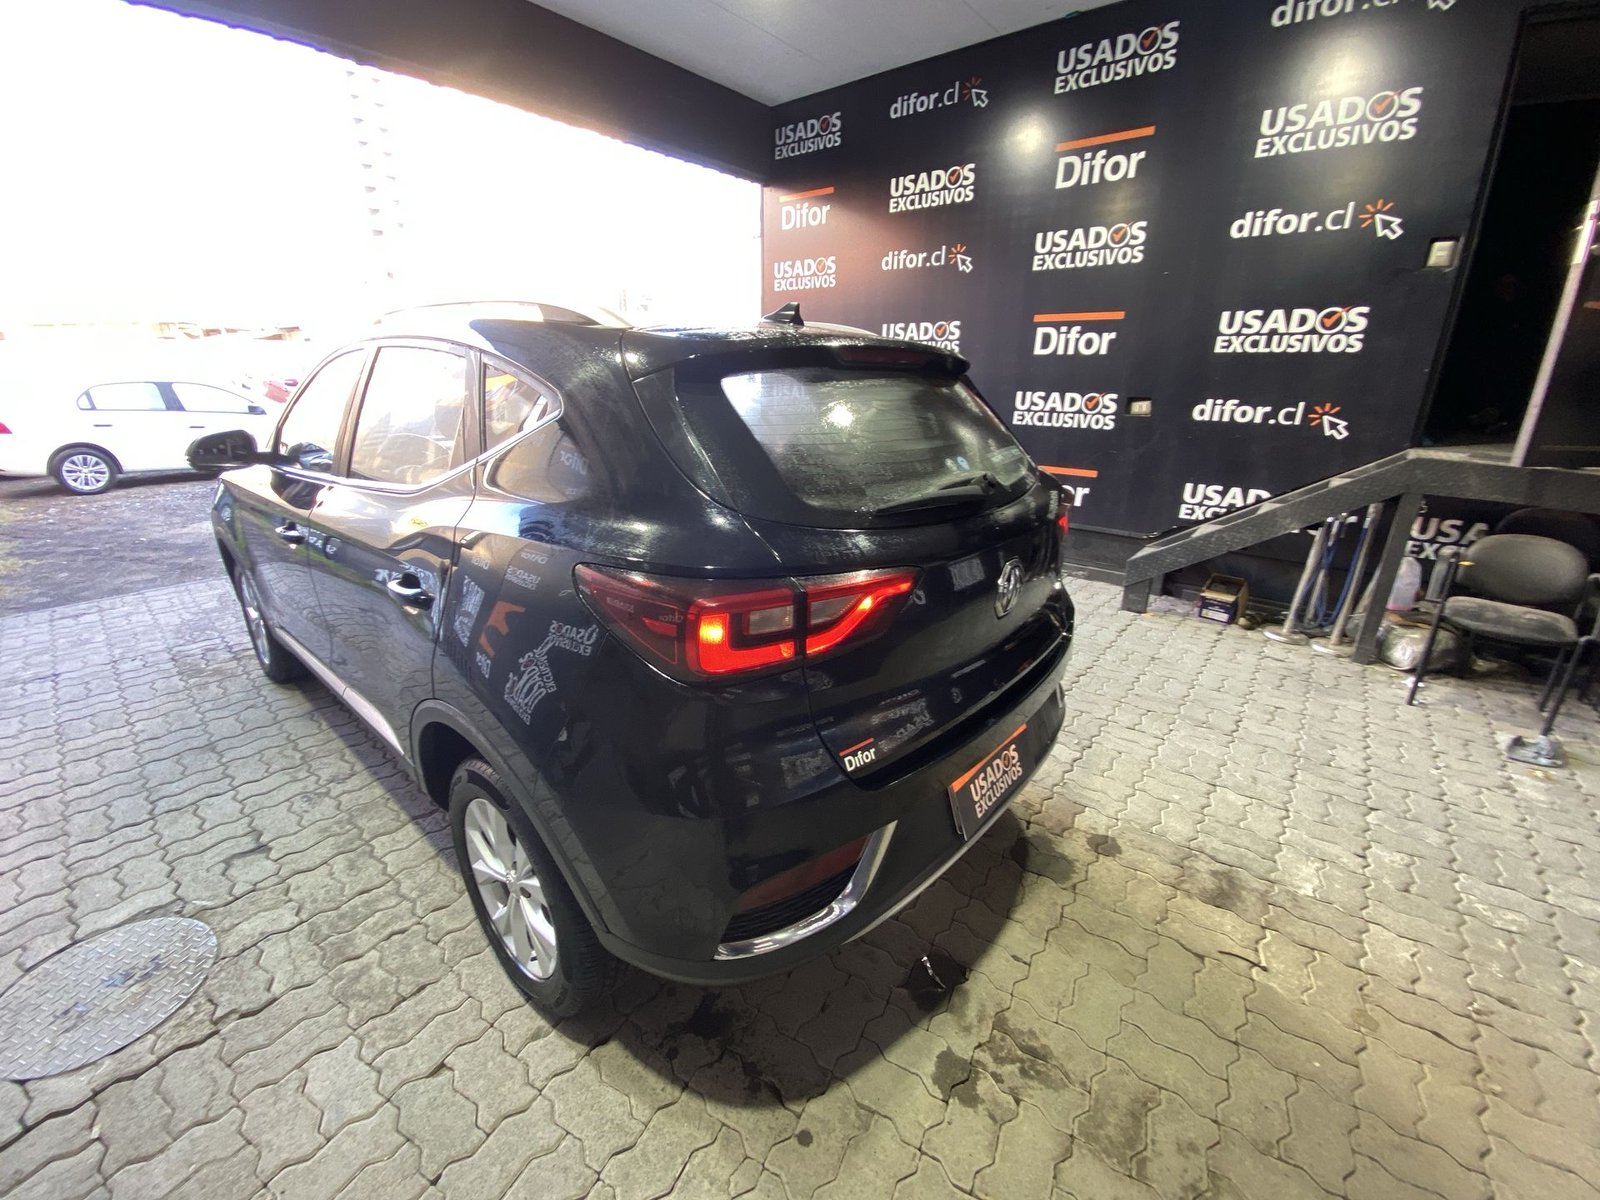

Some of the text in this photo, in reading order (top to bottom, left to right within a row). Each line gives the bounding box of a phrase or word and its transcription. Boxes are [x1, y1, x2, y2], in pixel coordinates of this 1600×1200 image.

[1270, 0, 1399, 27] difor.
[1057, 20, 1180, 74] USADOS
[1054, 48, 1177, 94] EXCLUSIVOS
[889, 81, 960, 119] difor.cl
[1260, 87, 1423, 136] USADOS
[775, 112, 842, 145] USADOS
[1254, 118, 1418, 158] EXCLUSIVOS
[774, 135, 842, 160] EXCLUSIVOS
[890, 163, 976, 197] USADOS
[1055, 150, 1146, 190] Difor
[889, 185, 974, 213] EXCLUSIVOS
[781, 202, 830, 231] Difor
[1230, 202, 1356, 239] difor.cl
[1035, 221, 1148, 254] USADOS
[774, 256, 836, 279] USADOS
[881, 245, 946, 272] difor.cl
[1032, 246, 1144, 271] EXCLUSIVOS
[774, 273, 836, 291] EXCLUSIVOS
[882, 320, 961, 341] USADOS
[1218, 306, 1370, 334] USADOS
[1033, 326, 1117, 355] Difor
[1213, 333, 1365, 353] EXCLUSIVOS
[1015, 391, 1118, 414] USADOS
[1192, 399, 1306, 425] difor.cl
[1012, 411, 1116, 430] EXCLUSIVOS
[843, 746, 876, 772] Difor
[969, 743, 1019, 801] USADOS
[975, 763, 1023, 819] EXCLUSIVOS
